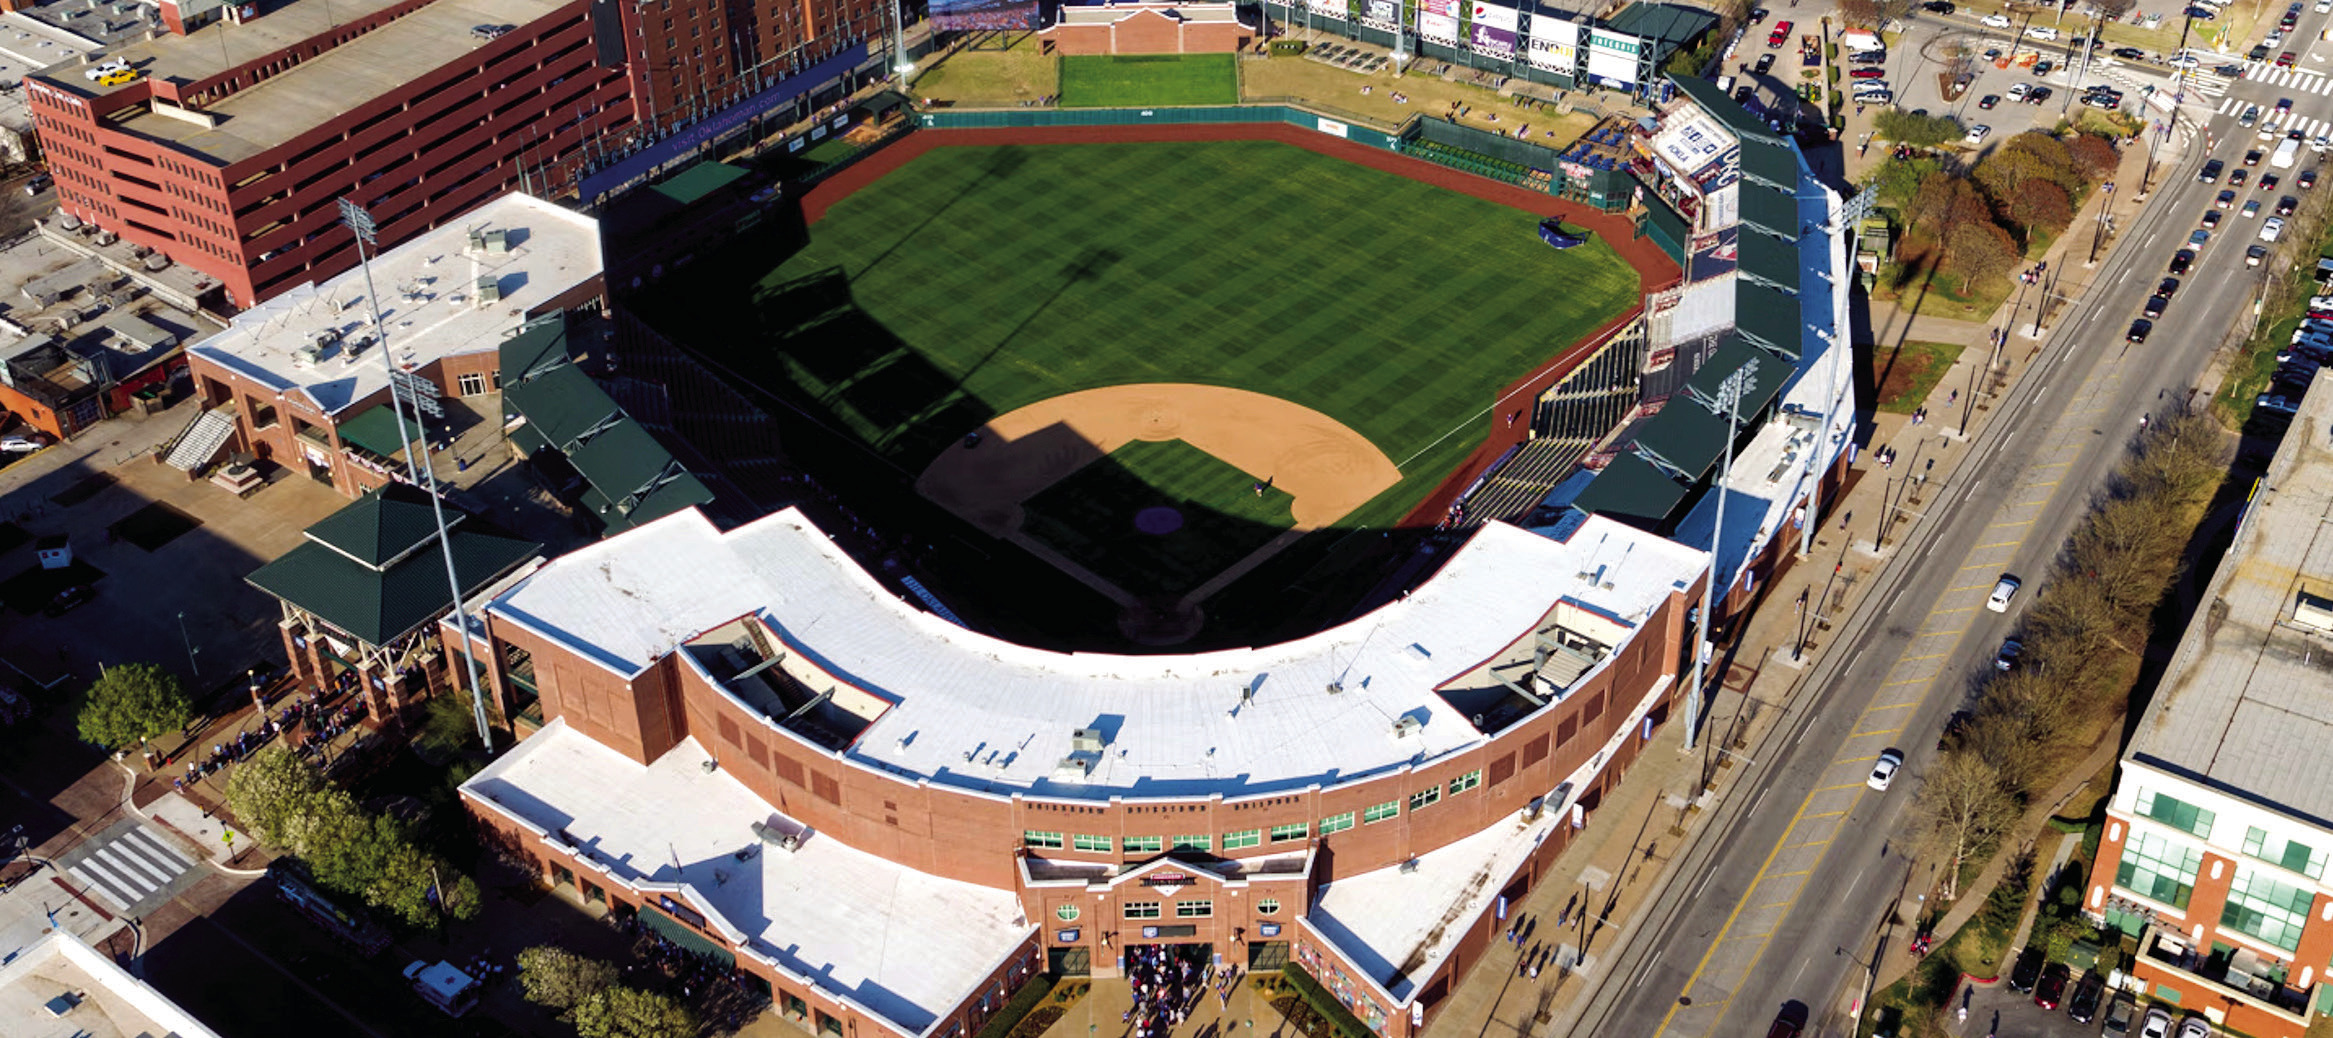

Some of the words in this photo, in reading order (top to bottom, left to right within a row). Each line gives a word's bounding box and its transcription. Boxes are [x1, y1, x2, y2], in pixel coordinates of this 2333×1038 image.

[576, 121, 682, 181] CHICKASAW
[691, 70, 786, 125] BRICKTOWN
[698, 91, 781, 139] Oklahoman.com
